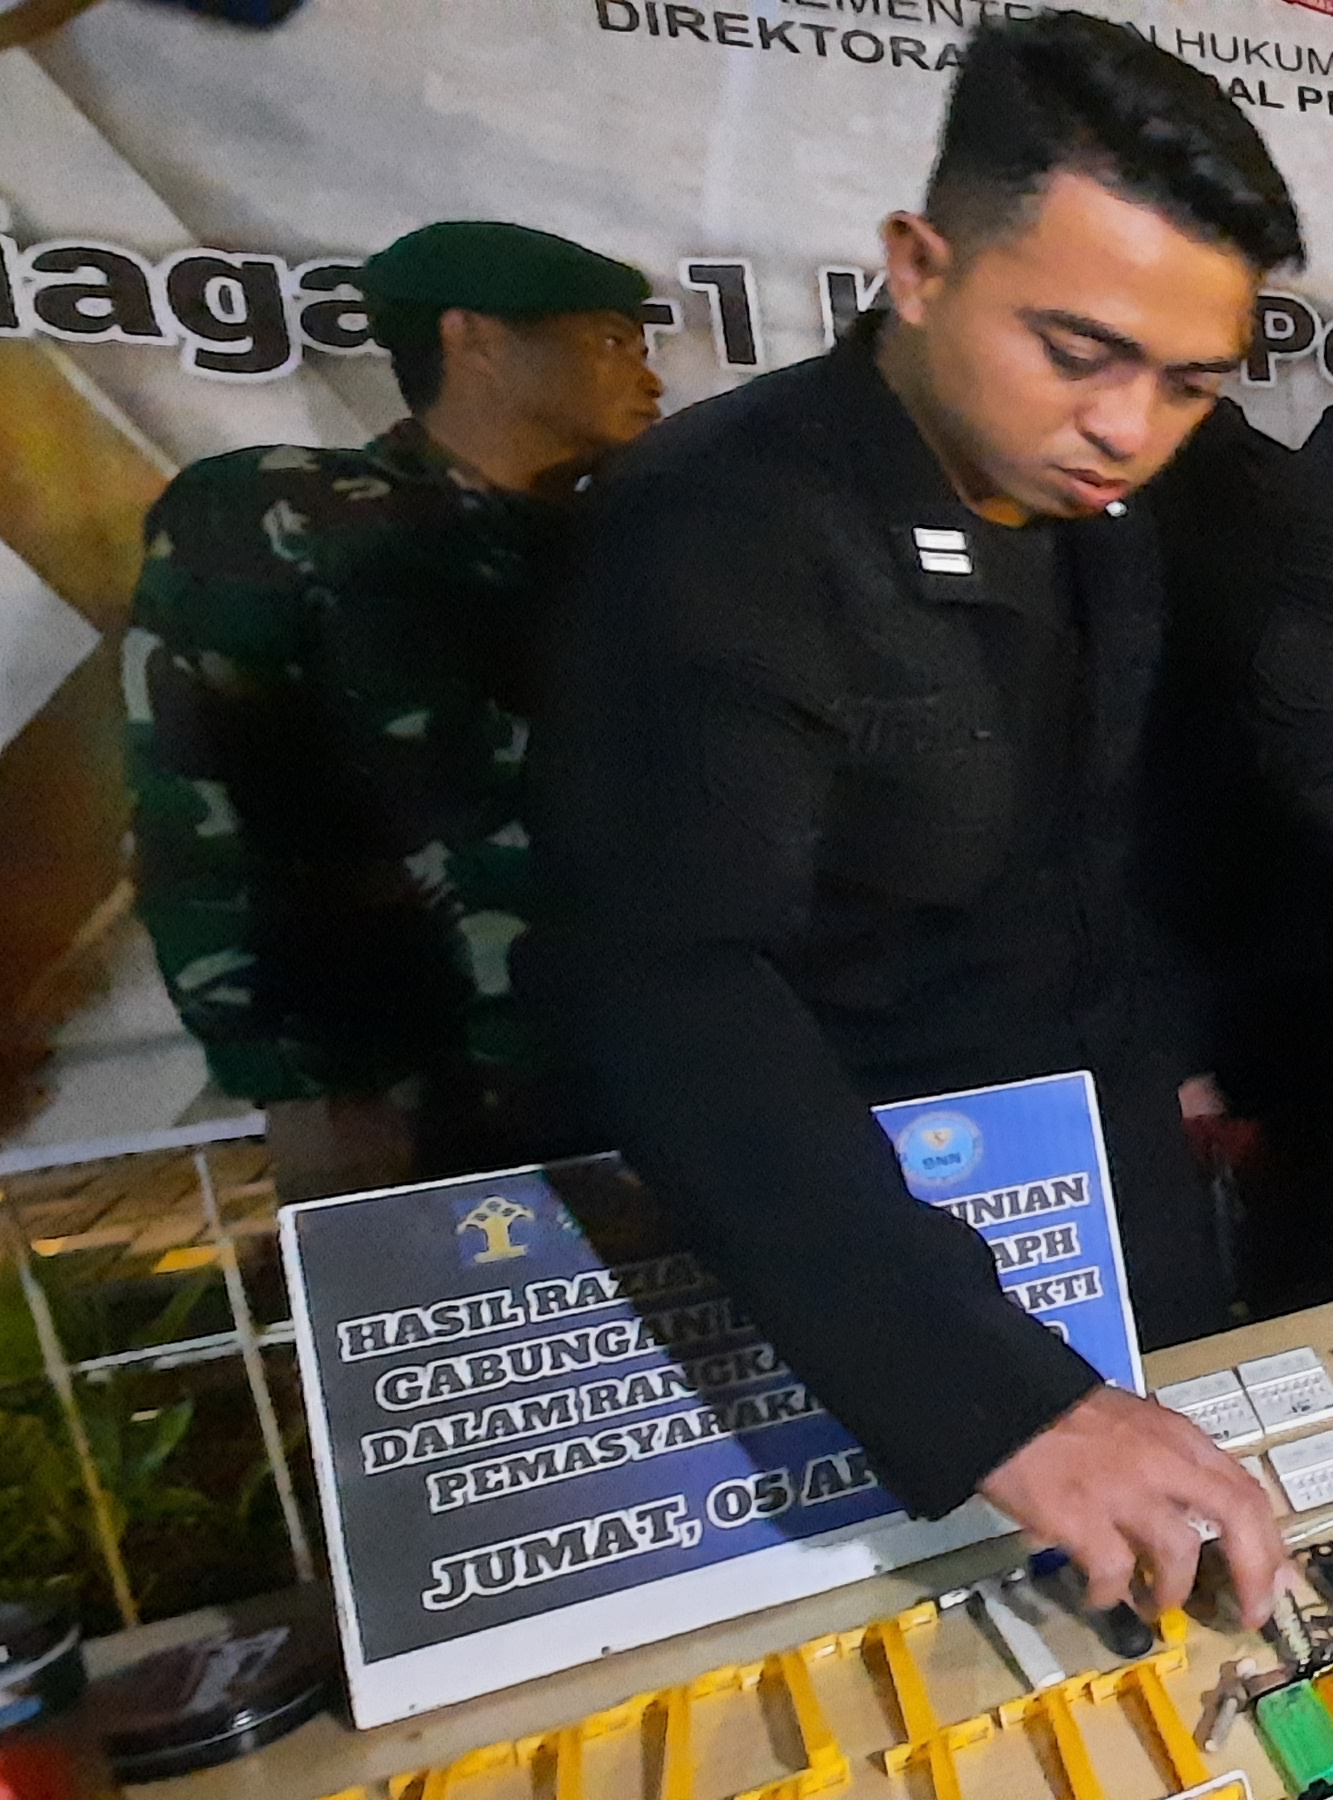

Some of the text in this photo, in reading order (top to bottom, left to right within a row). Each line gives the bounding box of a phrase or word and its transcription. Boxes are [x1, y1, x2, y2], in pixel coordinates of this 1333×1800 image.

[599, 0, 970, 72] DIREKTORA
[341, 1291, 522, 1360] HASIL
[943, 1173, 1089, 1228] UNIAN
[363, 1390, 576, 1472] DALAM
[583, 1344, 793, 1419] RANGK
[430, 1386, 818, 1510] PEMASYARAK
[424, 1495, 701, 1608] JUMAT,
[709, 1470, 791, 1526] 05
